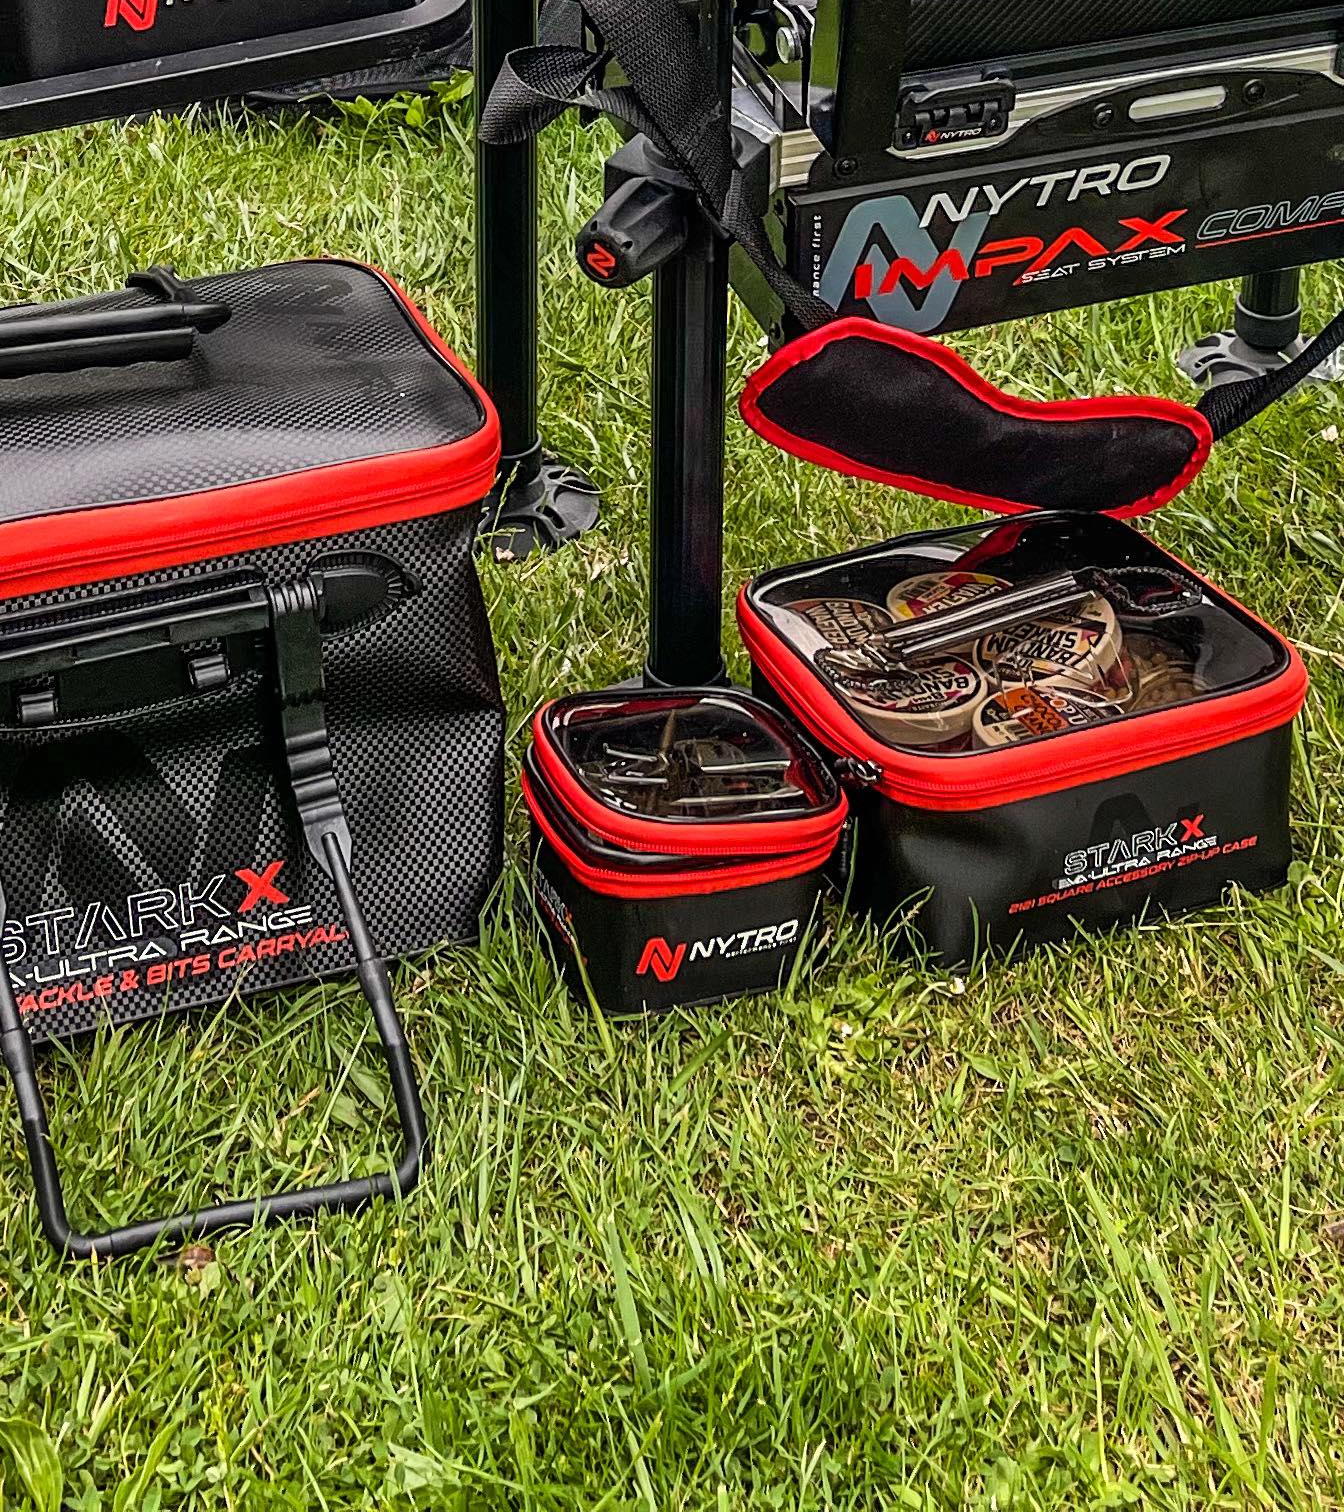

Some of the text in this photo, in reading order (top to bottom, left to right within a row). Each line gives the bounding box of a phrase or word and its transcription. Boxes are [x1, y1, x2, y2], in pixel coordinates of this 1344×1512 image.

[940, 127, 982, 139] NYTRO
[918, 155, 1171, 229] NYTRO
[854, 209, 1189, 300] IMPAX
[1020, 243, 1186, 284] SEAT SYSTEM
[1037, 882, 1094, 907] SQUARE
[1096, 859, 1175, 891] ACCESSORY
[1222, 834, 1258, 854] CASE
[1157, 835, 1218, 862] RANGE
[180, 905, 314, 952] RANGE
[689, 919, 799, 962] NYTRO
[14, 974, 114, 1015] ACKLE
[123, 970, 140, 993] &
[146, 953, 210, 986] BITS
[218, 924, 350, 970] CARRYAL
